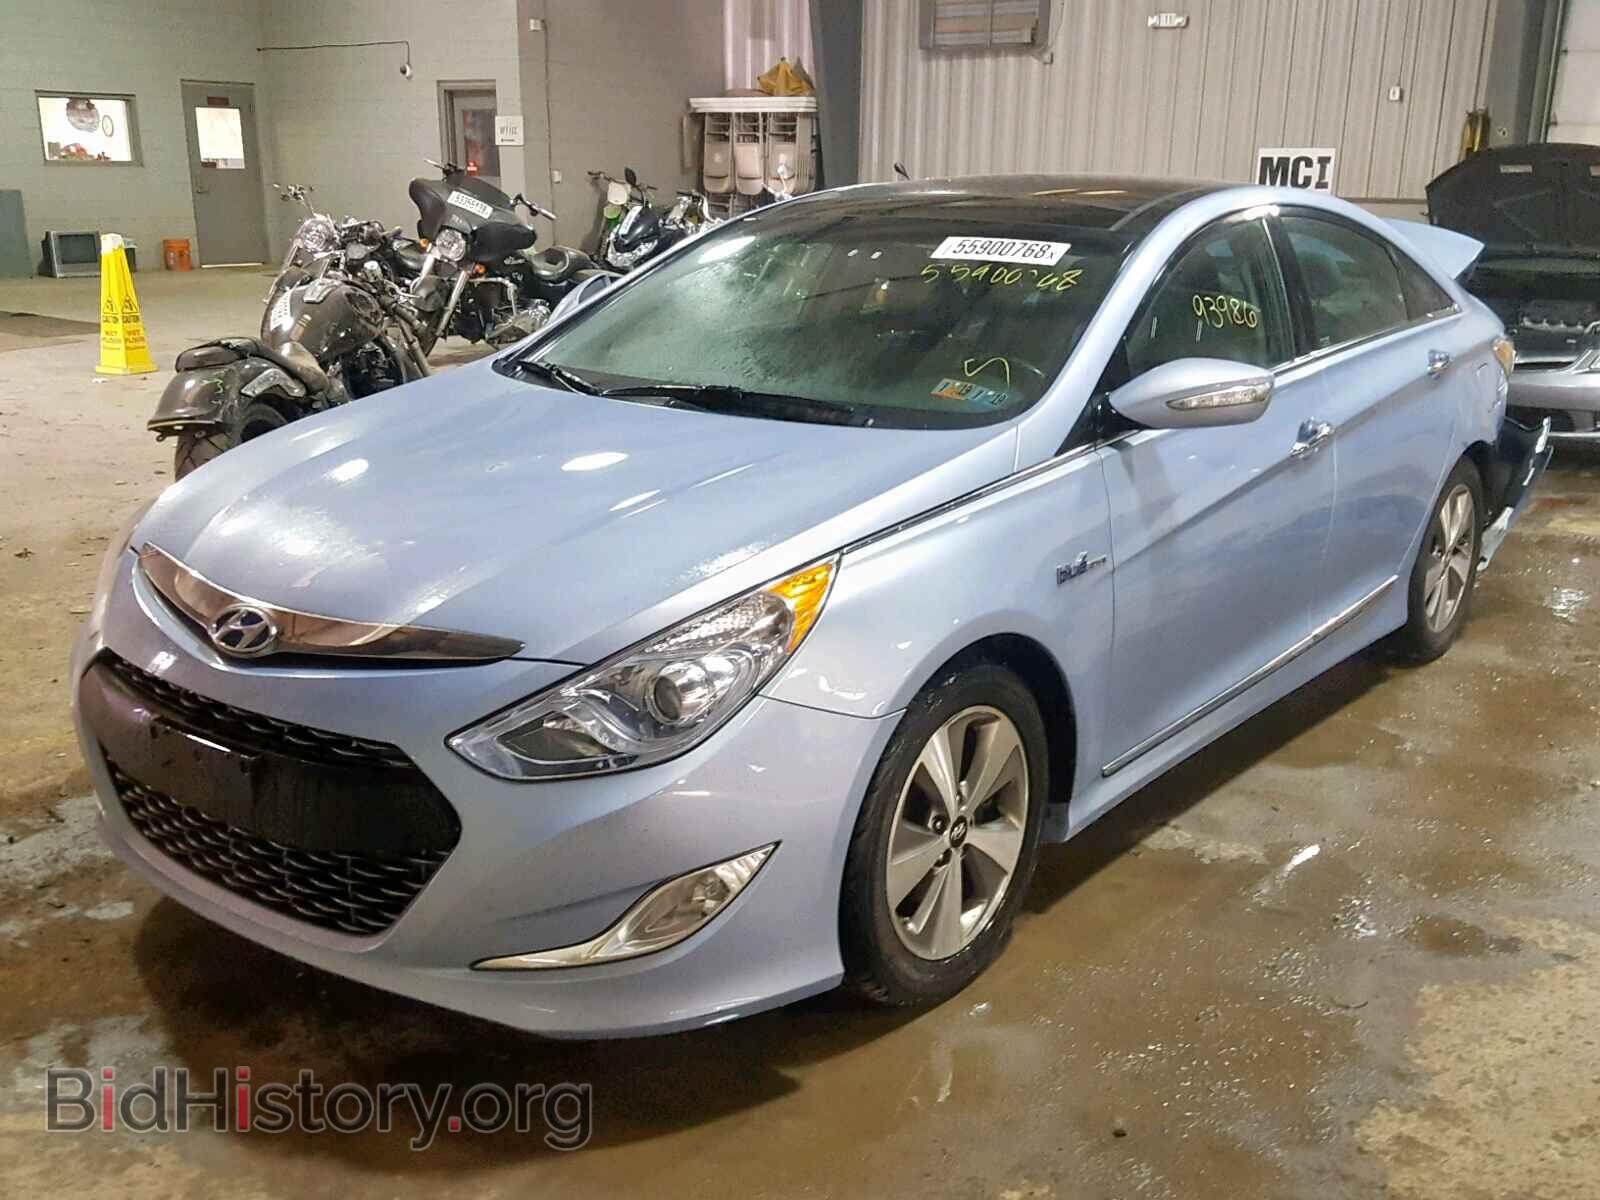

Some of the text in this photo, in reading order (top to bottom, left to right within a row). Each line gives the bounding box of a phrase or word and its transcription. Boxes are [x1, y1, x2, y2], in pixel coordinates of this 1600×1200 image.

[1259, 155, 1332, 189] MCI
[952, 239, 1051, 260] 55900768
[1192, 294, 1257, 328] 93986
